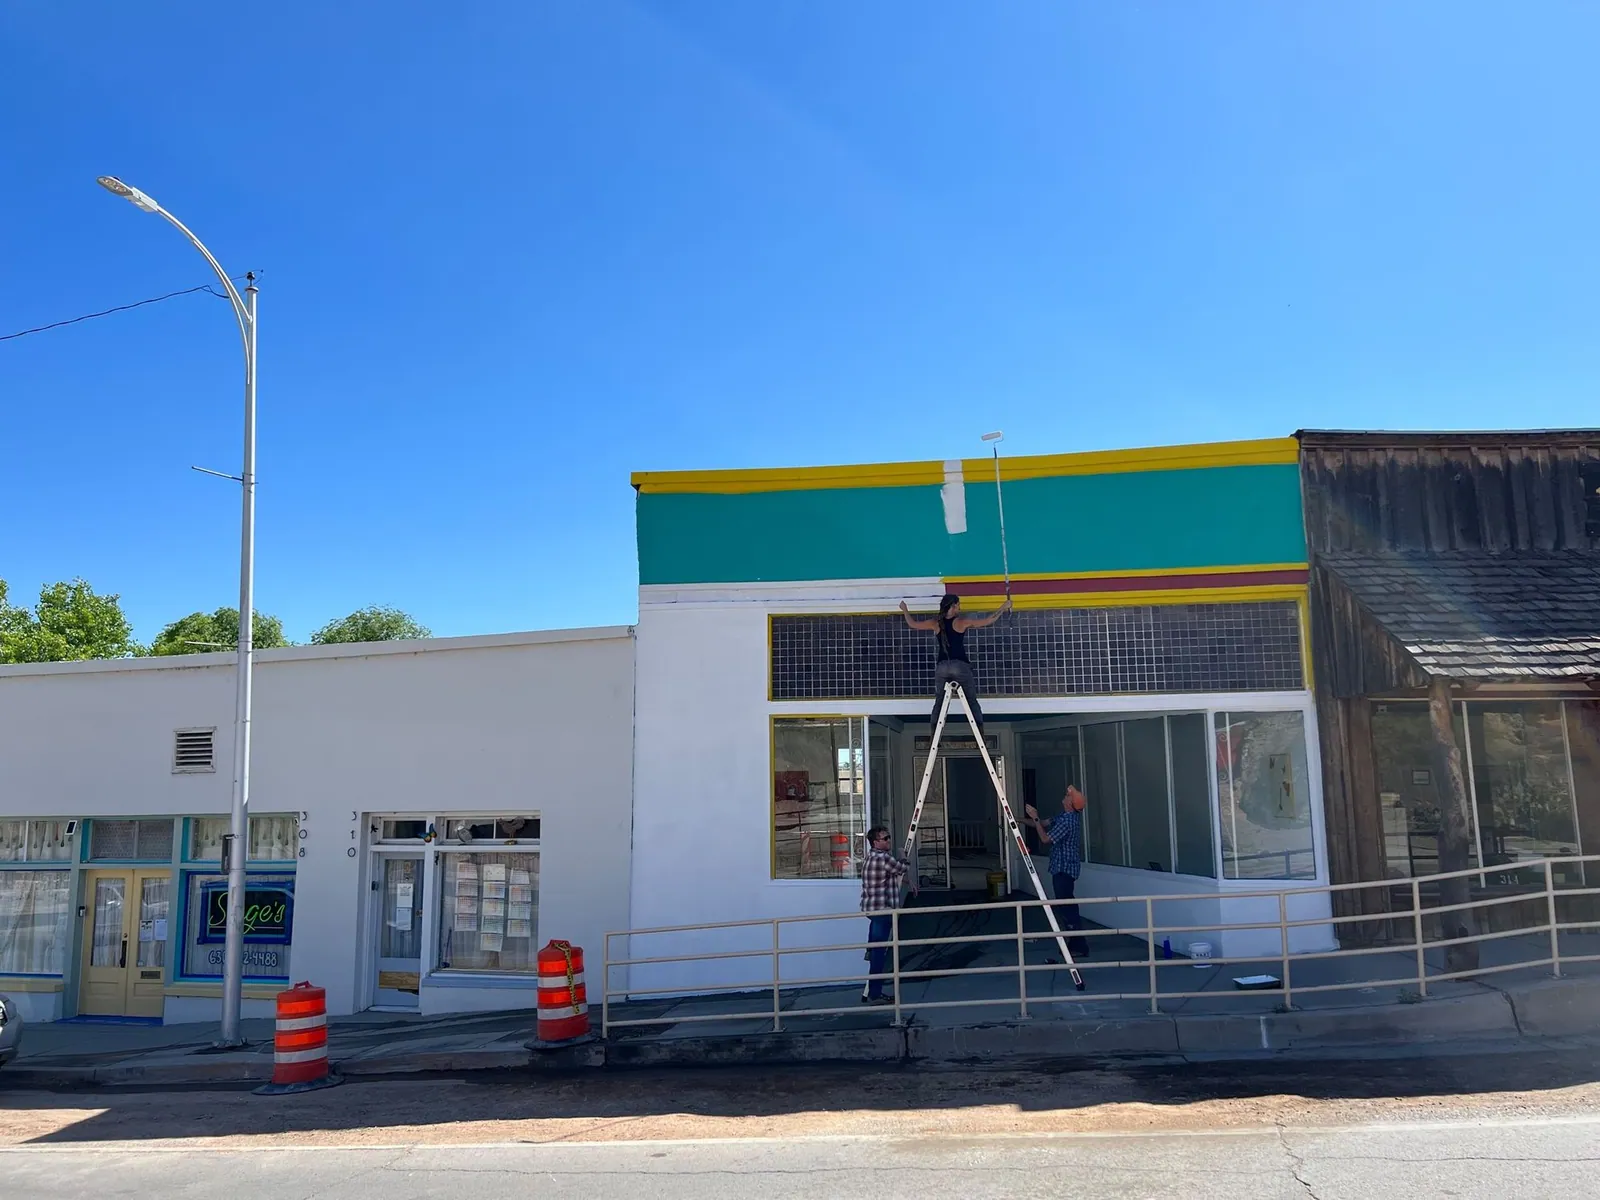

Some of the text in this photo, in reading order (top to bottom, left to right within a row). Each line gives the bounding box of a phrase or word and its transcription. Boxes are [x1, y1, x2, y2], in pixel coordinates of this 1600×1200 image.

[298, 811, 308, 858] 308
[347, 811, 358, 858] 310
[208, 891, 286, 935] Sge's
